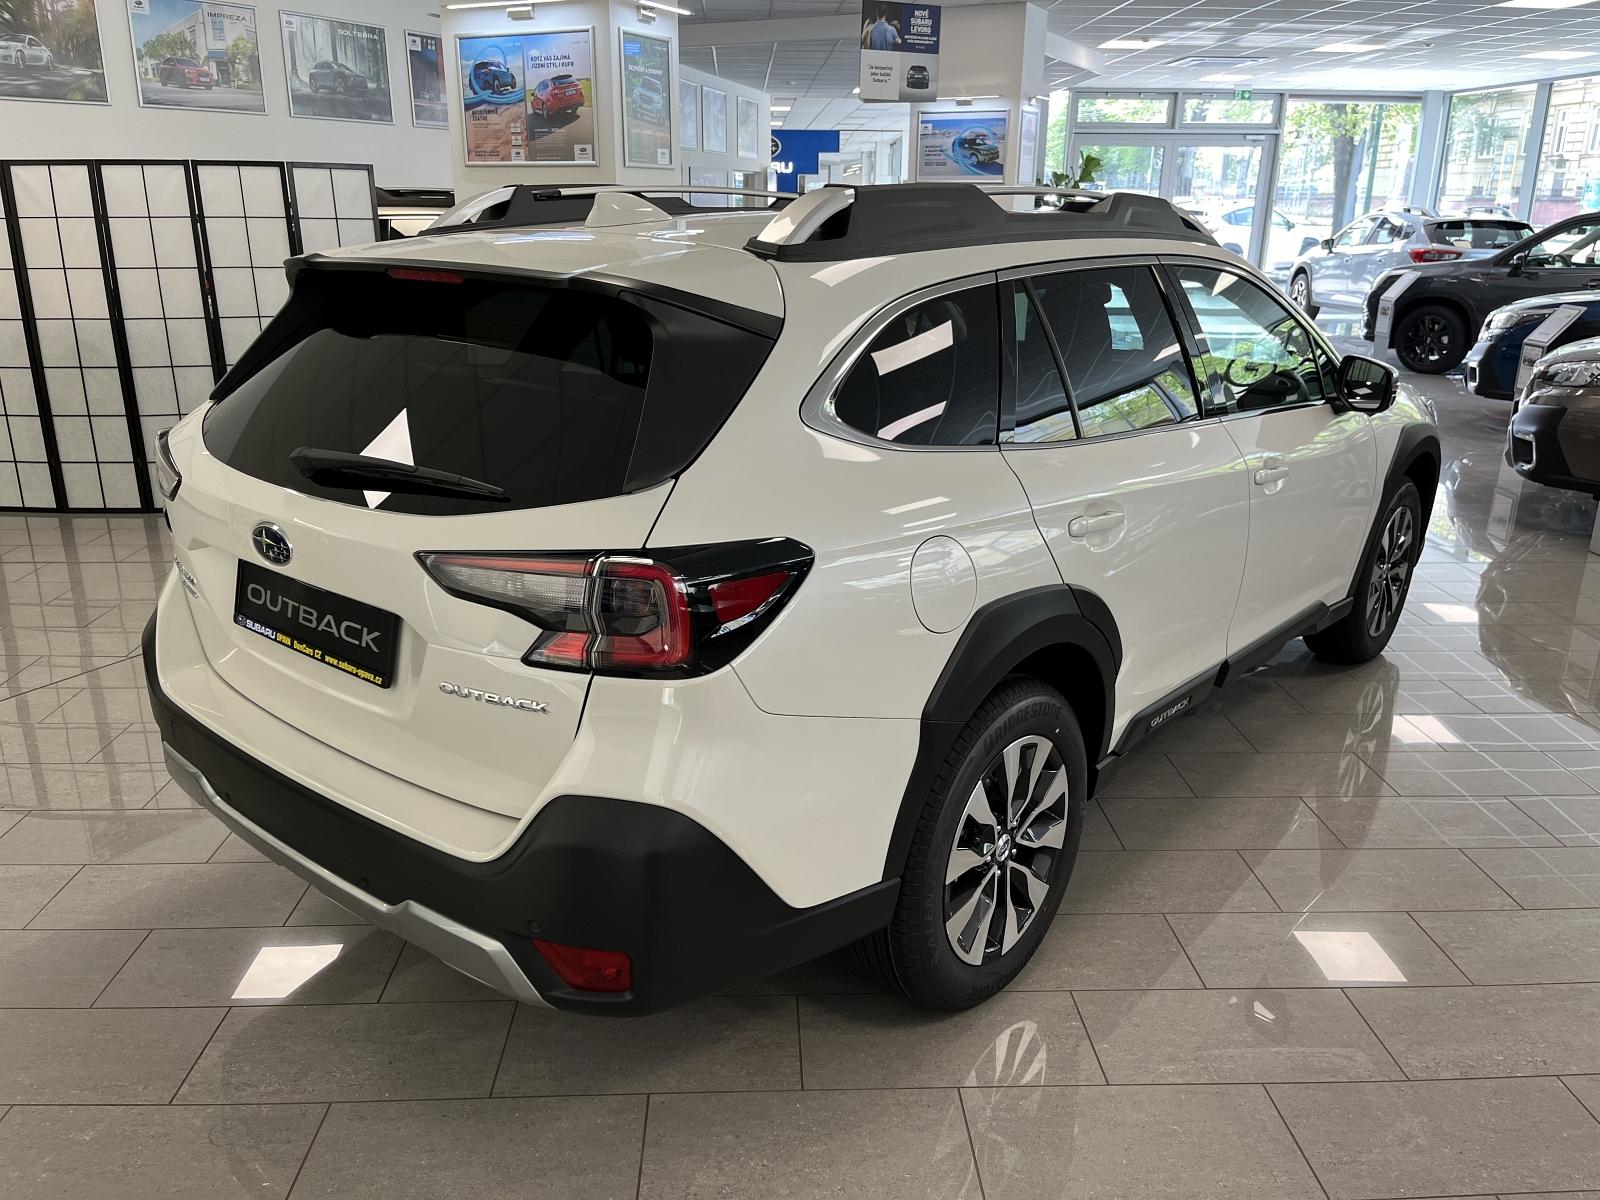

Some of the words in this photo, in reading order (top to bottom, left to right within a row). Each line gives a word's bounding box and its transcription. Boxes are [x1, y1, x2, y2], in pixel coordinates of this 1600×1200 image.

[207, 11, 247, 22] IMPREZA
[337, 28, 379, 40] SOLTERRA
[247, 582, 384, 654] OUTBACK
[245, 619, 276, 639] SUBARU
[276, 632, 292, 646] OPAVA
[293, 640, 314, 656] DanCars
[314, 649, 322, 660] CZ
[324, 654, 383, 685] www.subaru-opava.cz
[439, 681, 551, 714] OUTBACK
[1150, 696, 1190, 728] OUTBACK
[983, 701, 1063, 758] BRIDGESTONE
